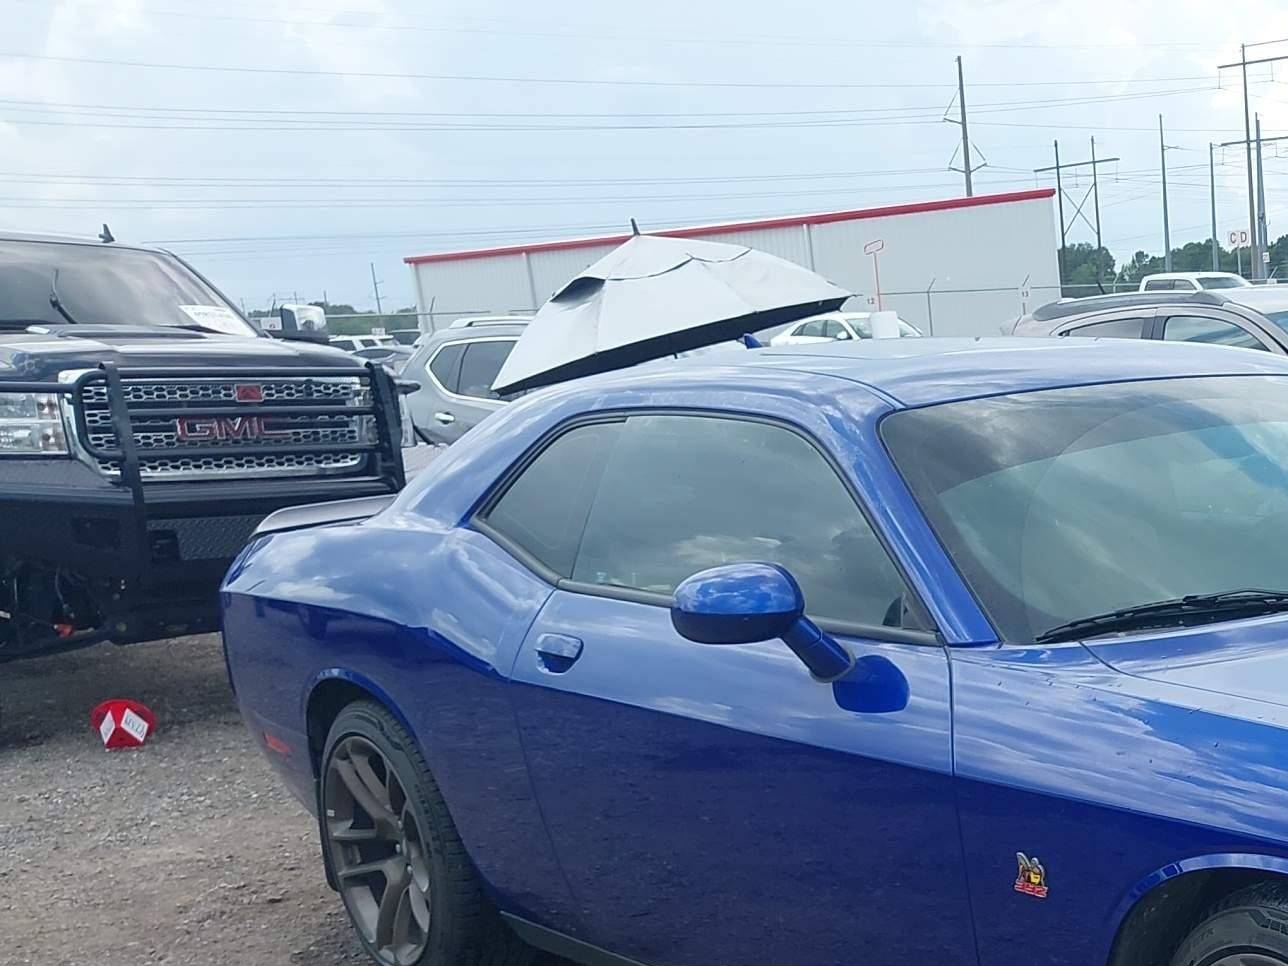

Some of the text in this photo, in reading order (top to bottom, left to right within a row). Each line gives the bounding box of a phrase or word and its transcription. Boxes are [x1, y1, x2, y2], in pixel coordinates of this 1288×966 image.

[1230, 231, 1247, 243] C D
[176, 416, 291, 440] GMC
